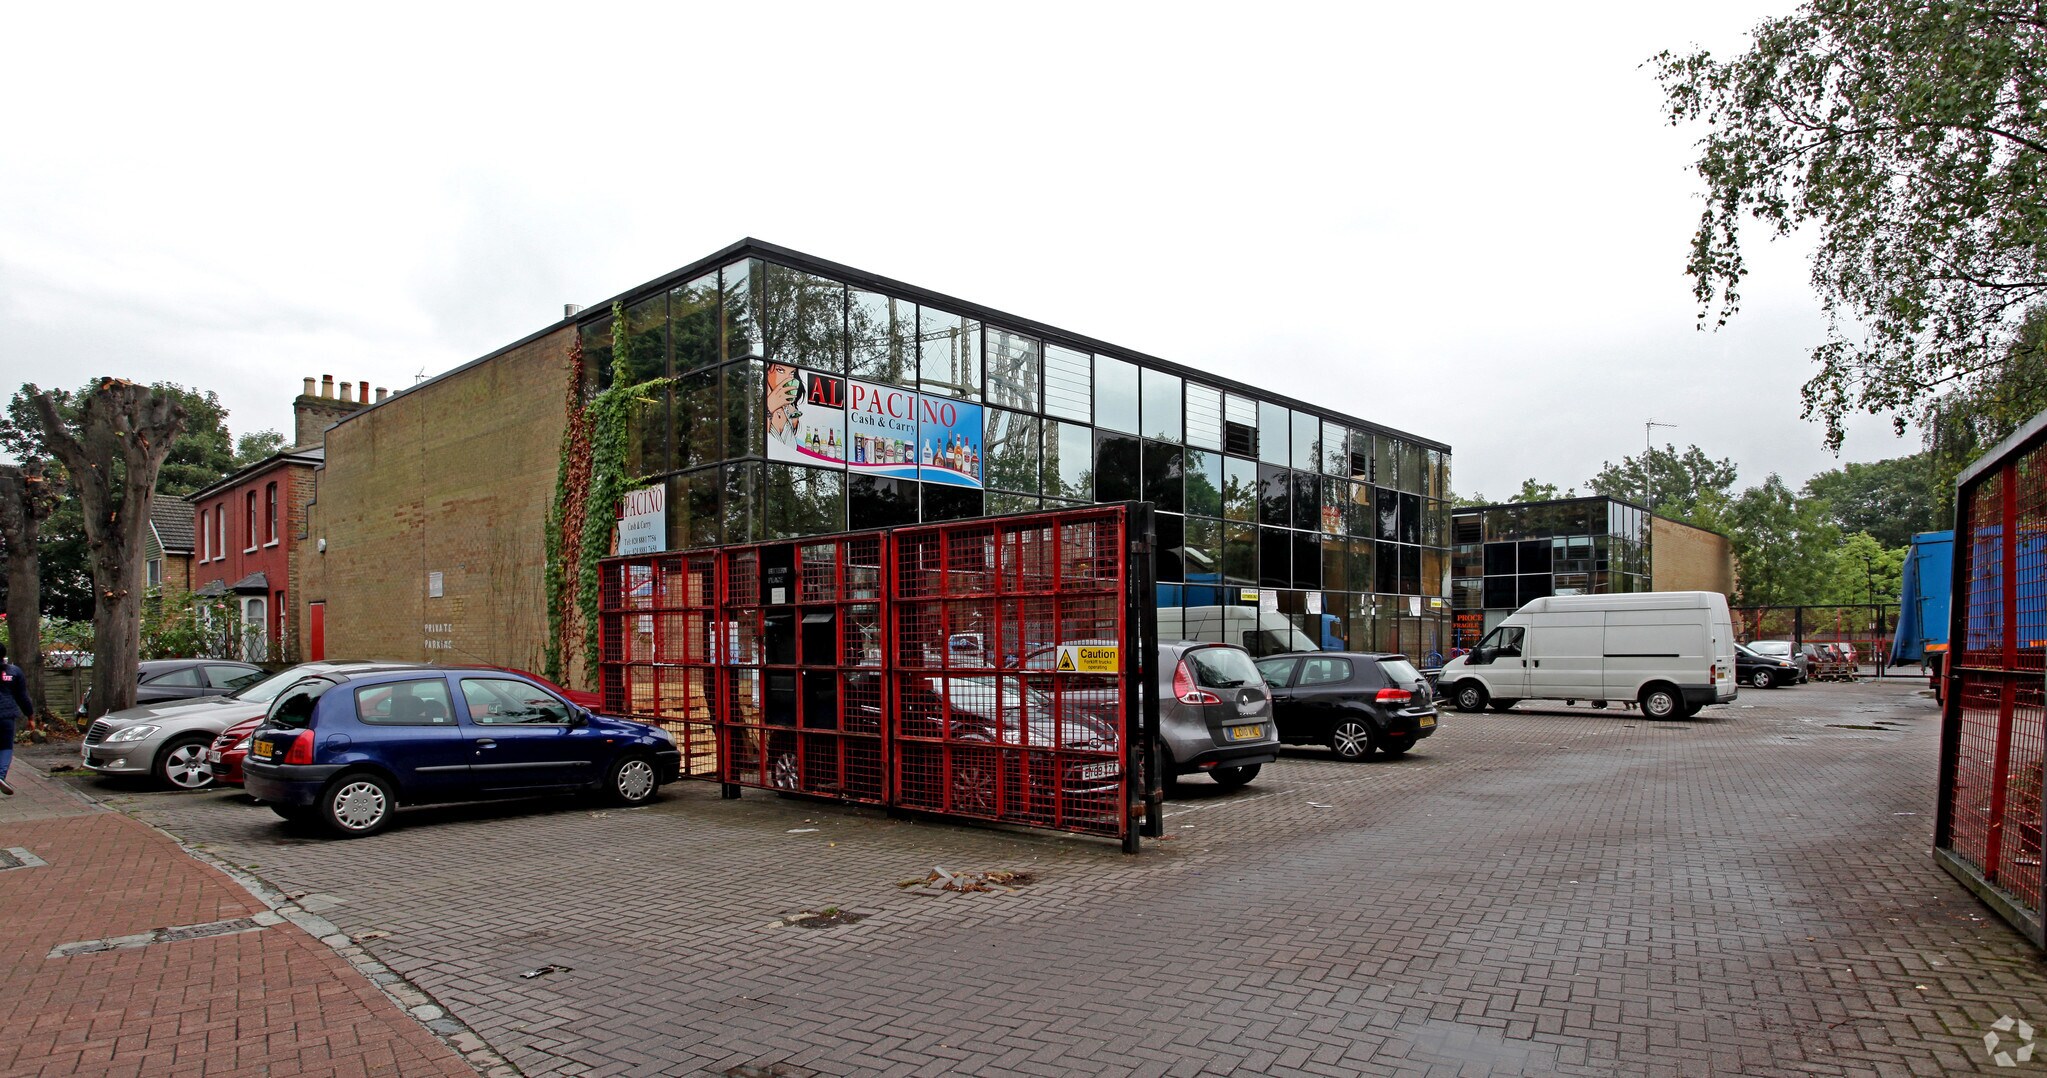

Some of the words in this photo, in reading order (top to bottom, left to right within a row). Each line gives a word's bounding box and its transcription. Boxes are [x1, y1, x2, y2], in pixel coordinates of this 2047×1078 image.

[810, 377, 843, 407] AL
[851, 384, 957, 428] PACINO
[851, 412, 875, 427] Cash
[877, 417, 886, 428] &
[889, 418, 916, 436] Carry
[625, 489, 663, 517] PACINO
[627, 522, 637, 531] Cash
[640, 521, 651, 529] Carry
[424, 623, 452, 633] PRIVATE
[424, 639, 452, 649] PARKING
[1080, 648, 1116, 659] Caution
